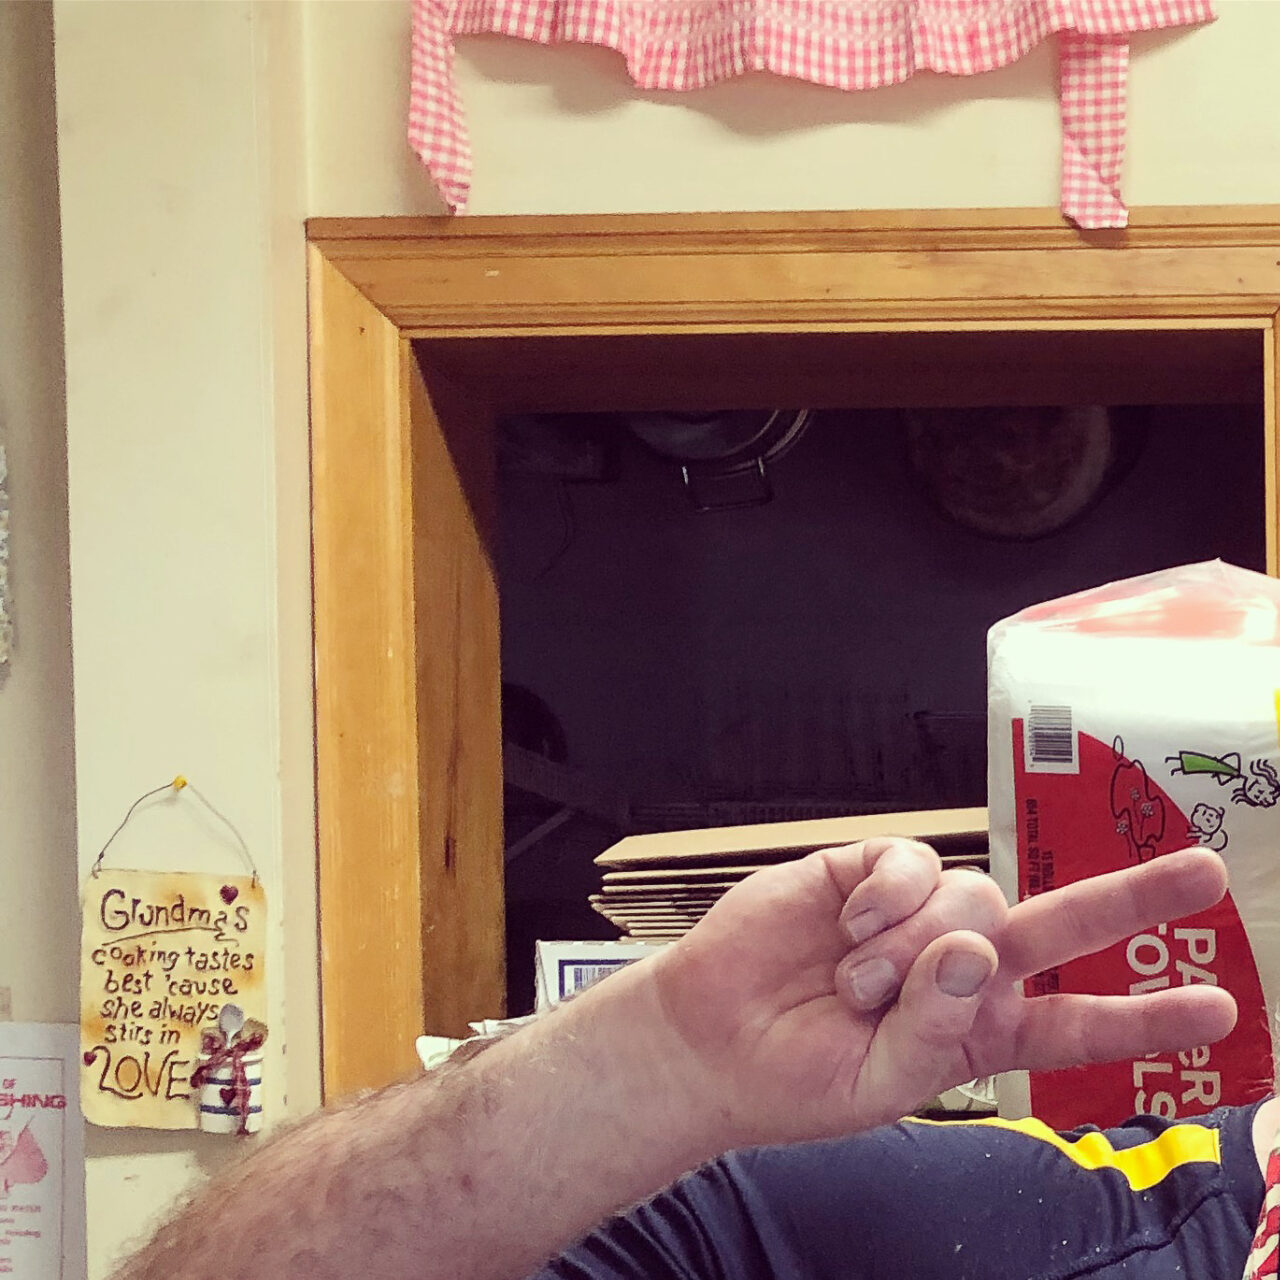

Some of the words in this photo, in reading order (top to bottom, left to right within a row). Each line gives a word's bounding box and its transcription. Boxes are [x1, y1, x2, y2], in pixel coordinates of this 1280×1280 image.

[91, 941, 180, 971] cooking
[185, 946, 255, 971] tastes
[104, 970, 154, 995] best
[165, 974, 238, 996] 'cause
[100, 996, 143, 1020] she
[148, 998, 219, 1025] always
[1174, 927, 1221, 1107] PAeR
[104, 1021, 153, 1045] stirs
[158, 1023, 181, 1044] in
[93, 1045, 190, 1100] LOVE
